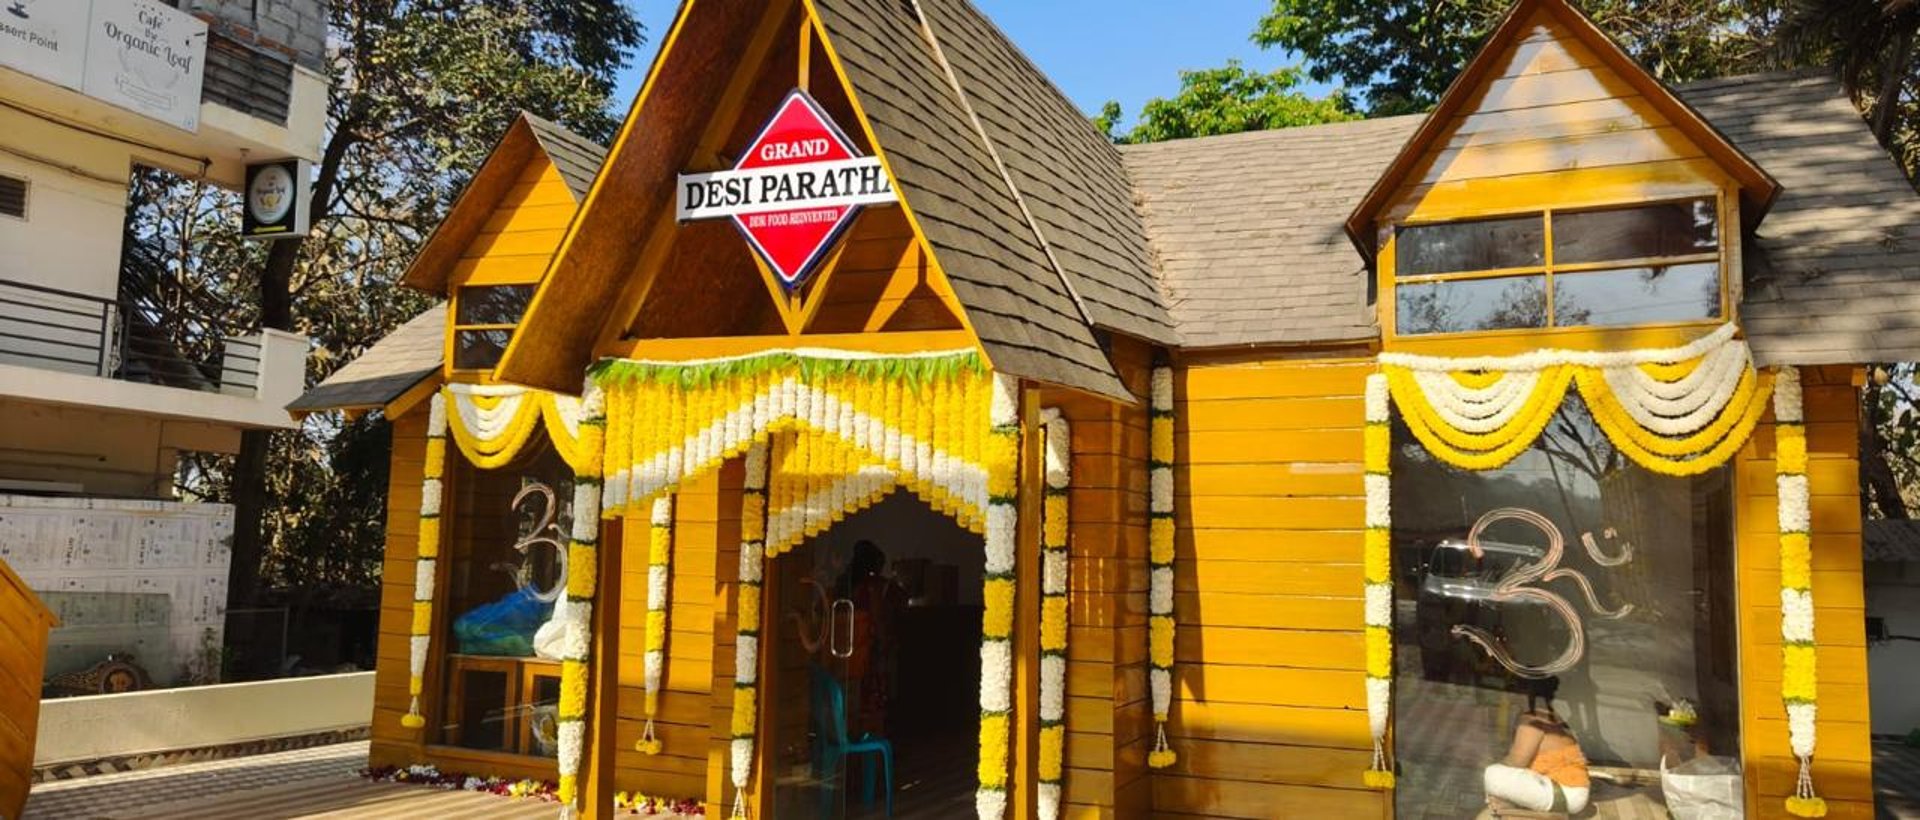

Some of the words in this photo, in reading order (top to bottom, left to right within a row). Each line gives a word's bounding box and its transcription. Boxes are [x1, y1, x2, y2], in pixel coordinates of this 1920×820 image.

[29, 32, 58, 51] Point
[104, 21, 161, 57] Organic
[760, 138, 829, 161] GRAND
[685, 177, 753, 211] DESI
[768, 213, 788, 226] FOOD
